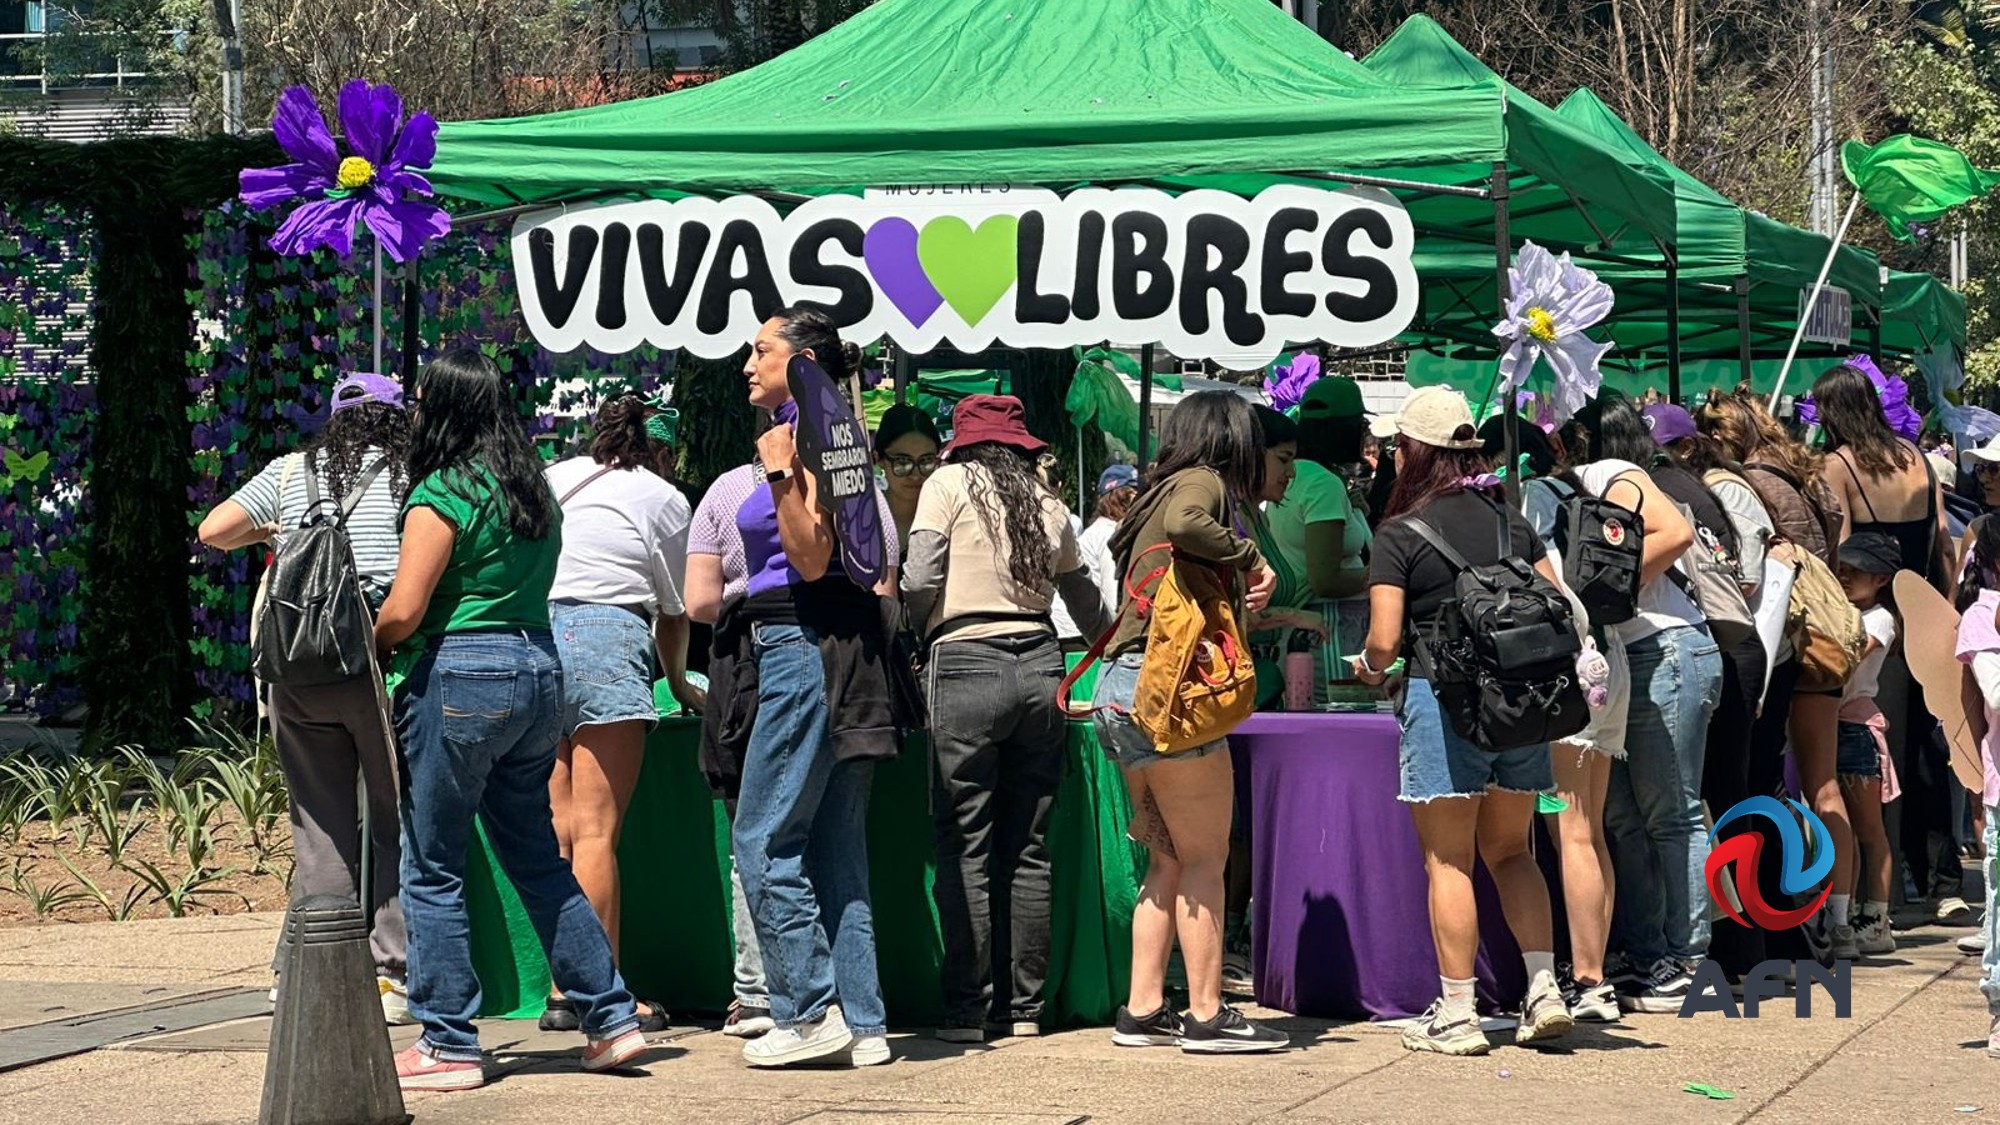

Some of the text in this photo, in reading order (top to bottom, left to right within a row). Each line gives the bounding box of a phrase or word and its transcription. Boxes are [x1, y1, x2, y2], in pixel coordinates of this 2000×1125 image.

[528, 207, 1398, 346] VIVAS LIBRES
[831, 423, 854, 448] NOS
[821, 447, 868, 471] SEMBRARON
[831, 467, 866, 497] MIEDO
